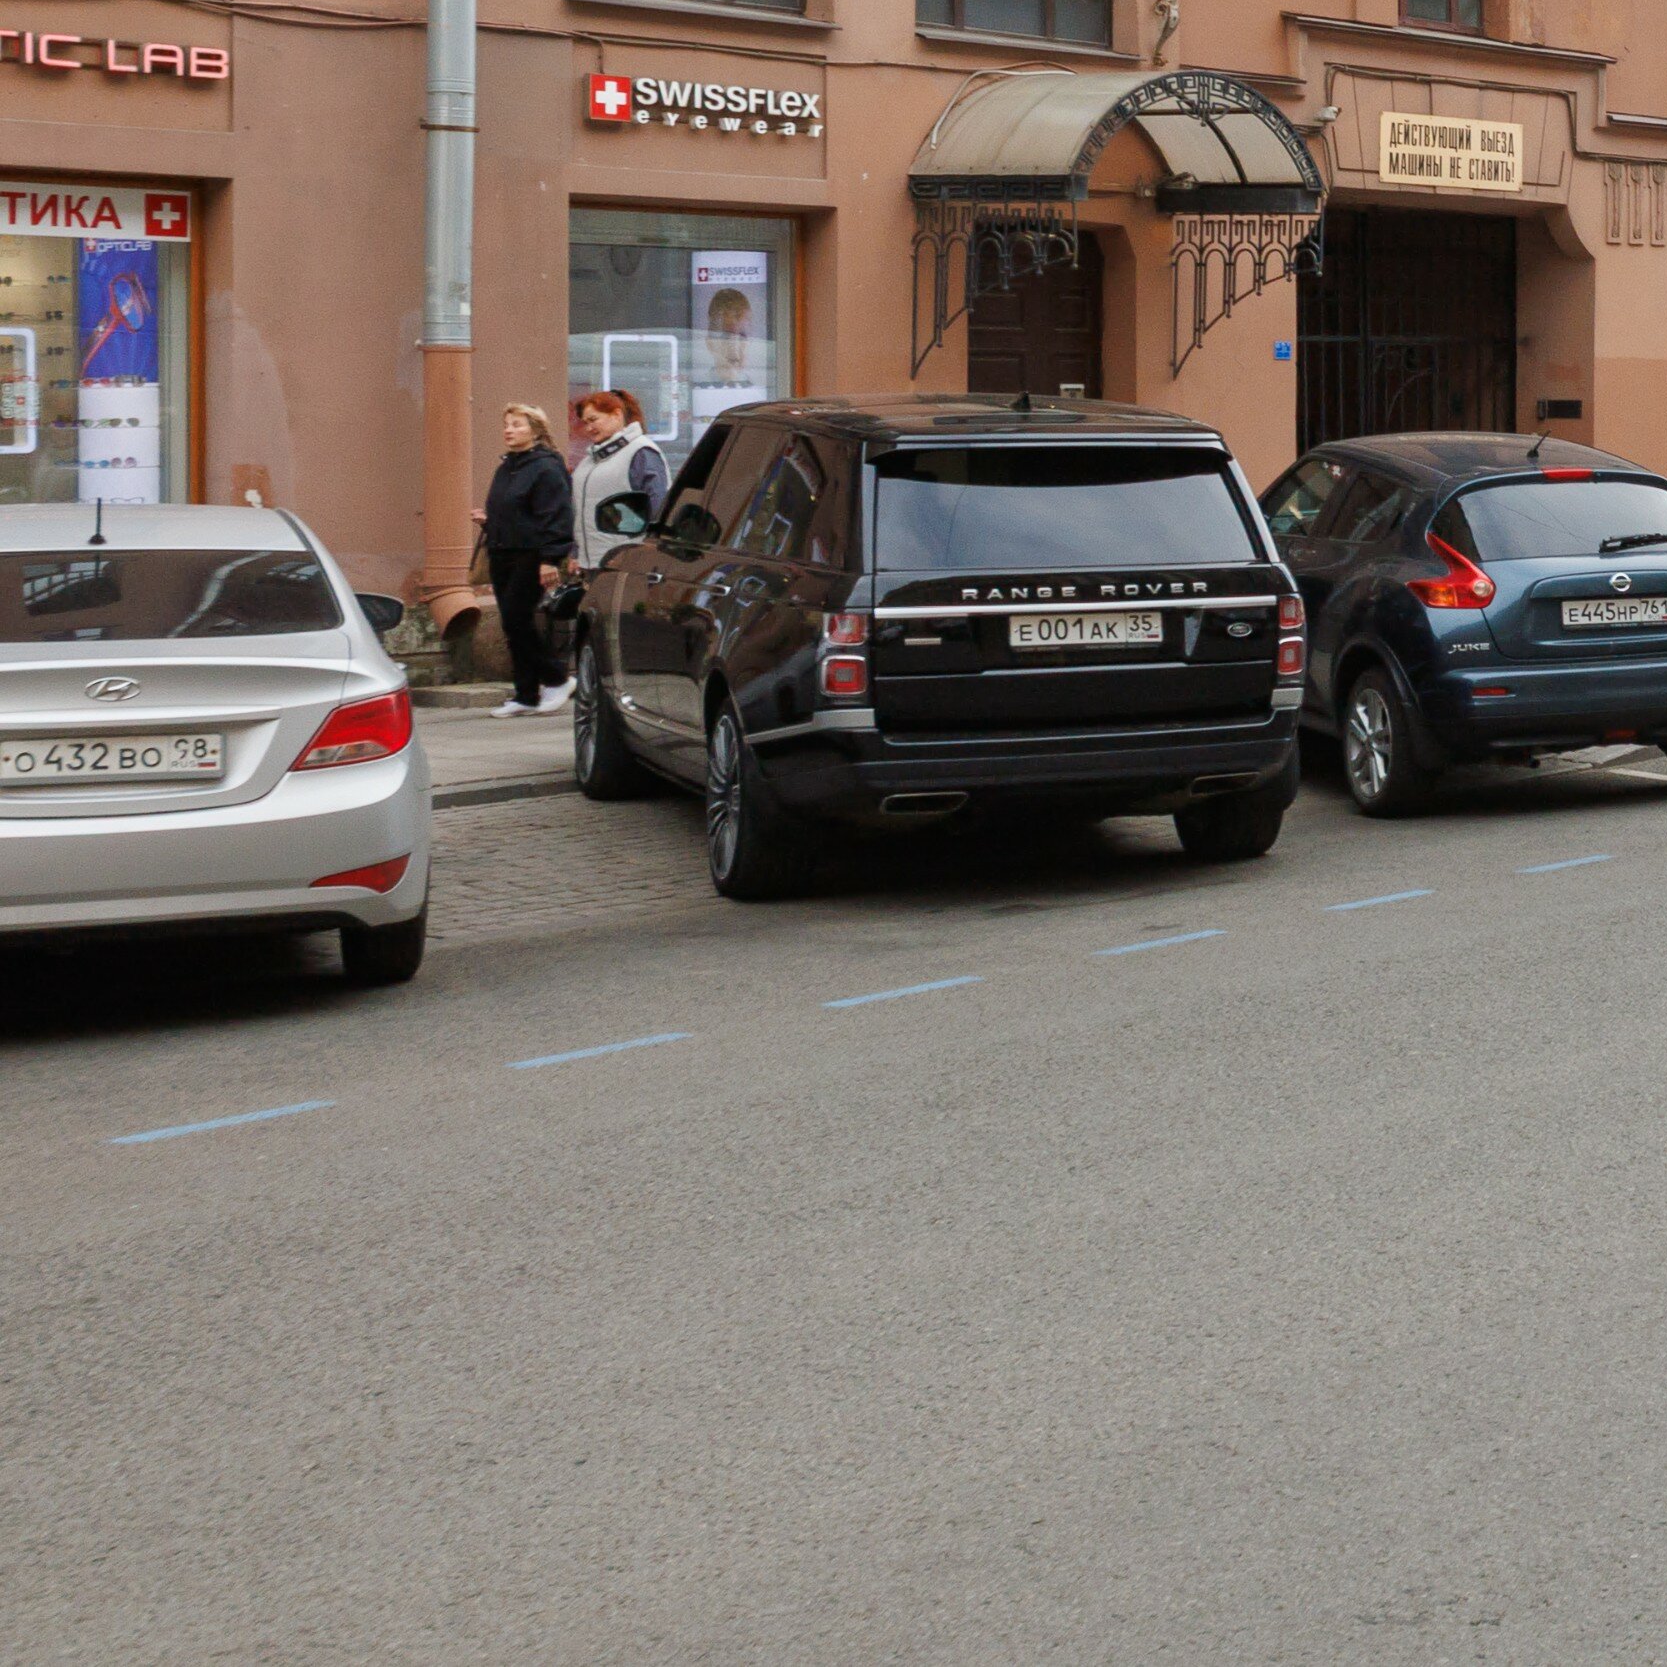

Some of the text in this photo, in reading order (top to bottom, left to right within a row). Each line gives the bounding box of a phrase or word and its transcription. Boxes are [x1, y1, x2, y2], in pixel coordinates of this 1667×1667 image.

[108, 39, 229, 79] LAB
[1389, 119, 1515, 157] ДЕЙСТВУЮЩИЙ ВЫЕЗД
[1388, 152, 1515, 183] МАШИНЫ НЕ СТАВИТЬ!
[962, 581, 1209, 601] RANGE ROVER
[1568, 600, 1639, 623] Е445НР
[1019, 614, 1153, 642] Е001АК 35
[1448, 642, 1490, 654] JUKE
